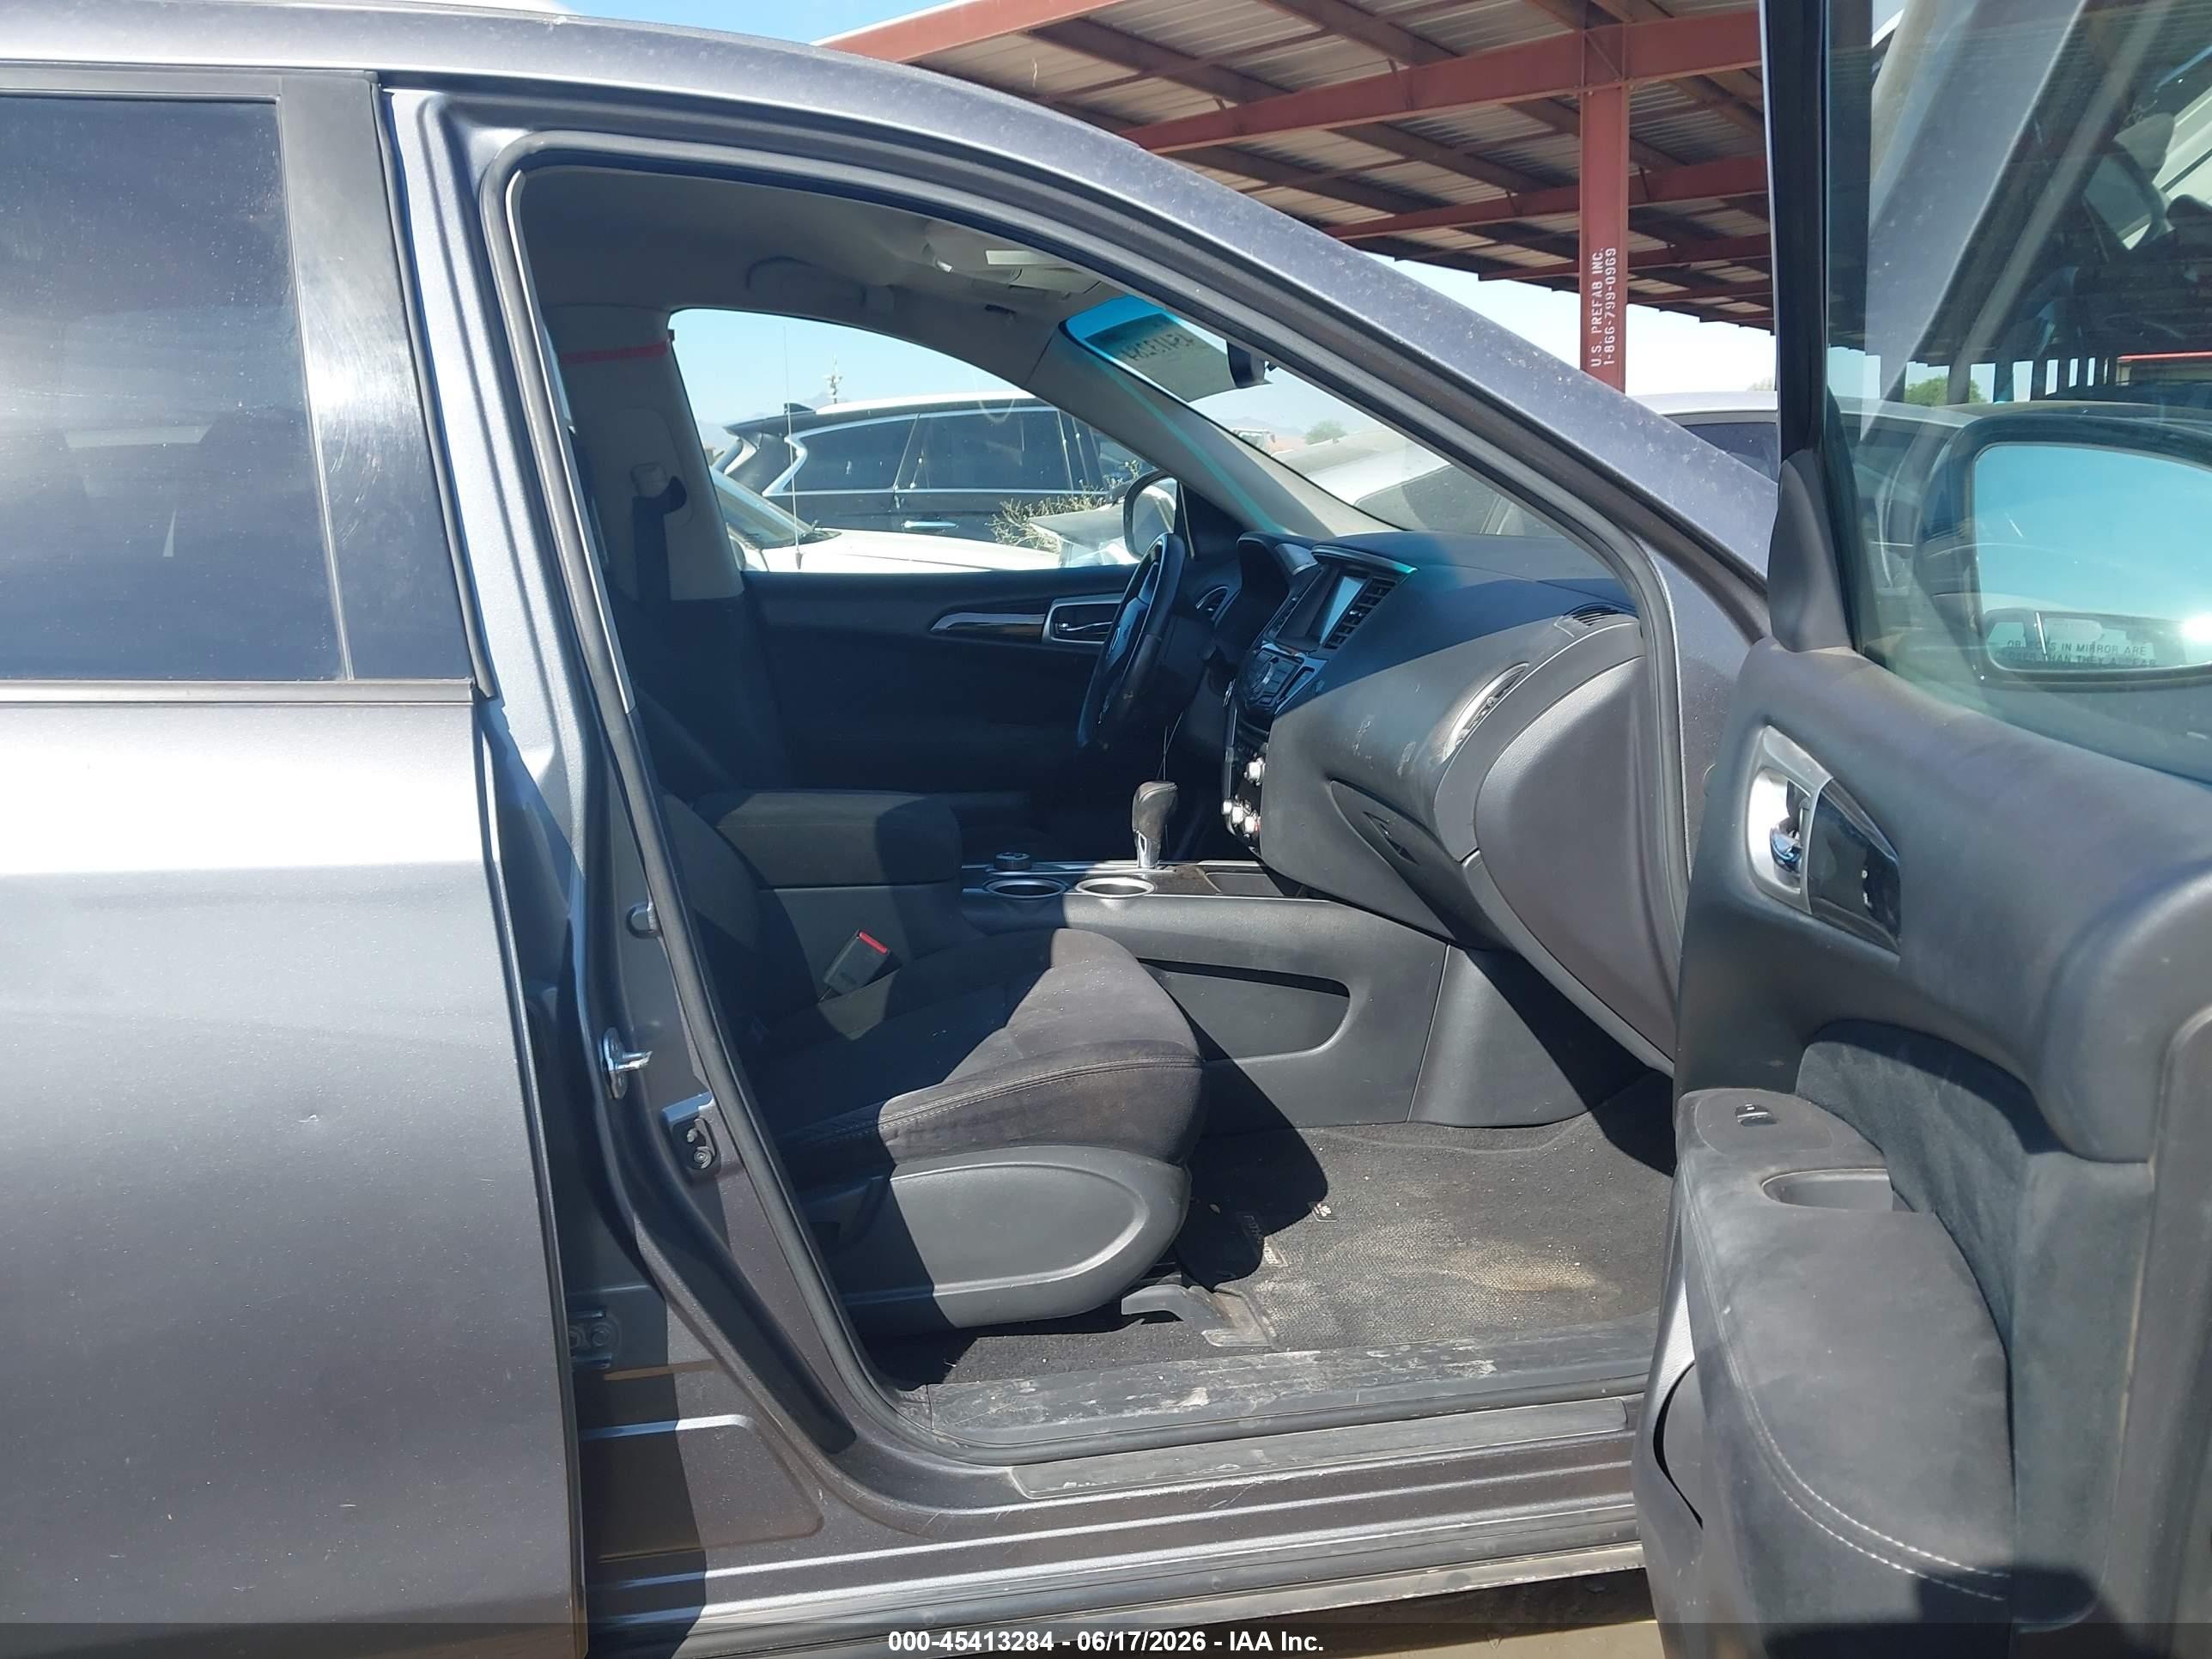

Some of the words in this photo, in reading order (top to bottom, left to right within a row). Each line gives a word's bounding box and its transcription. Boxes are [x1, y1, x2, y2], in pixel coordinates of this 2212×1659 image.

[1592, 247, 1604, 274] INC.
[1591, 281, 1603, 333] PREFAB
[1603, 247, 1617, 365] 1-866-799-0969
[1590, 341, 1602, 368] U.S.
[2007, 640, 2057, 652] OBECS
[2061, 643, 2072, 652] IN
[2076, 642, 2118, 653] MIRROR
[2124, 646, 2147, 656] ARE
[2109, 656, 2157, 667] AEAR
